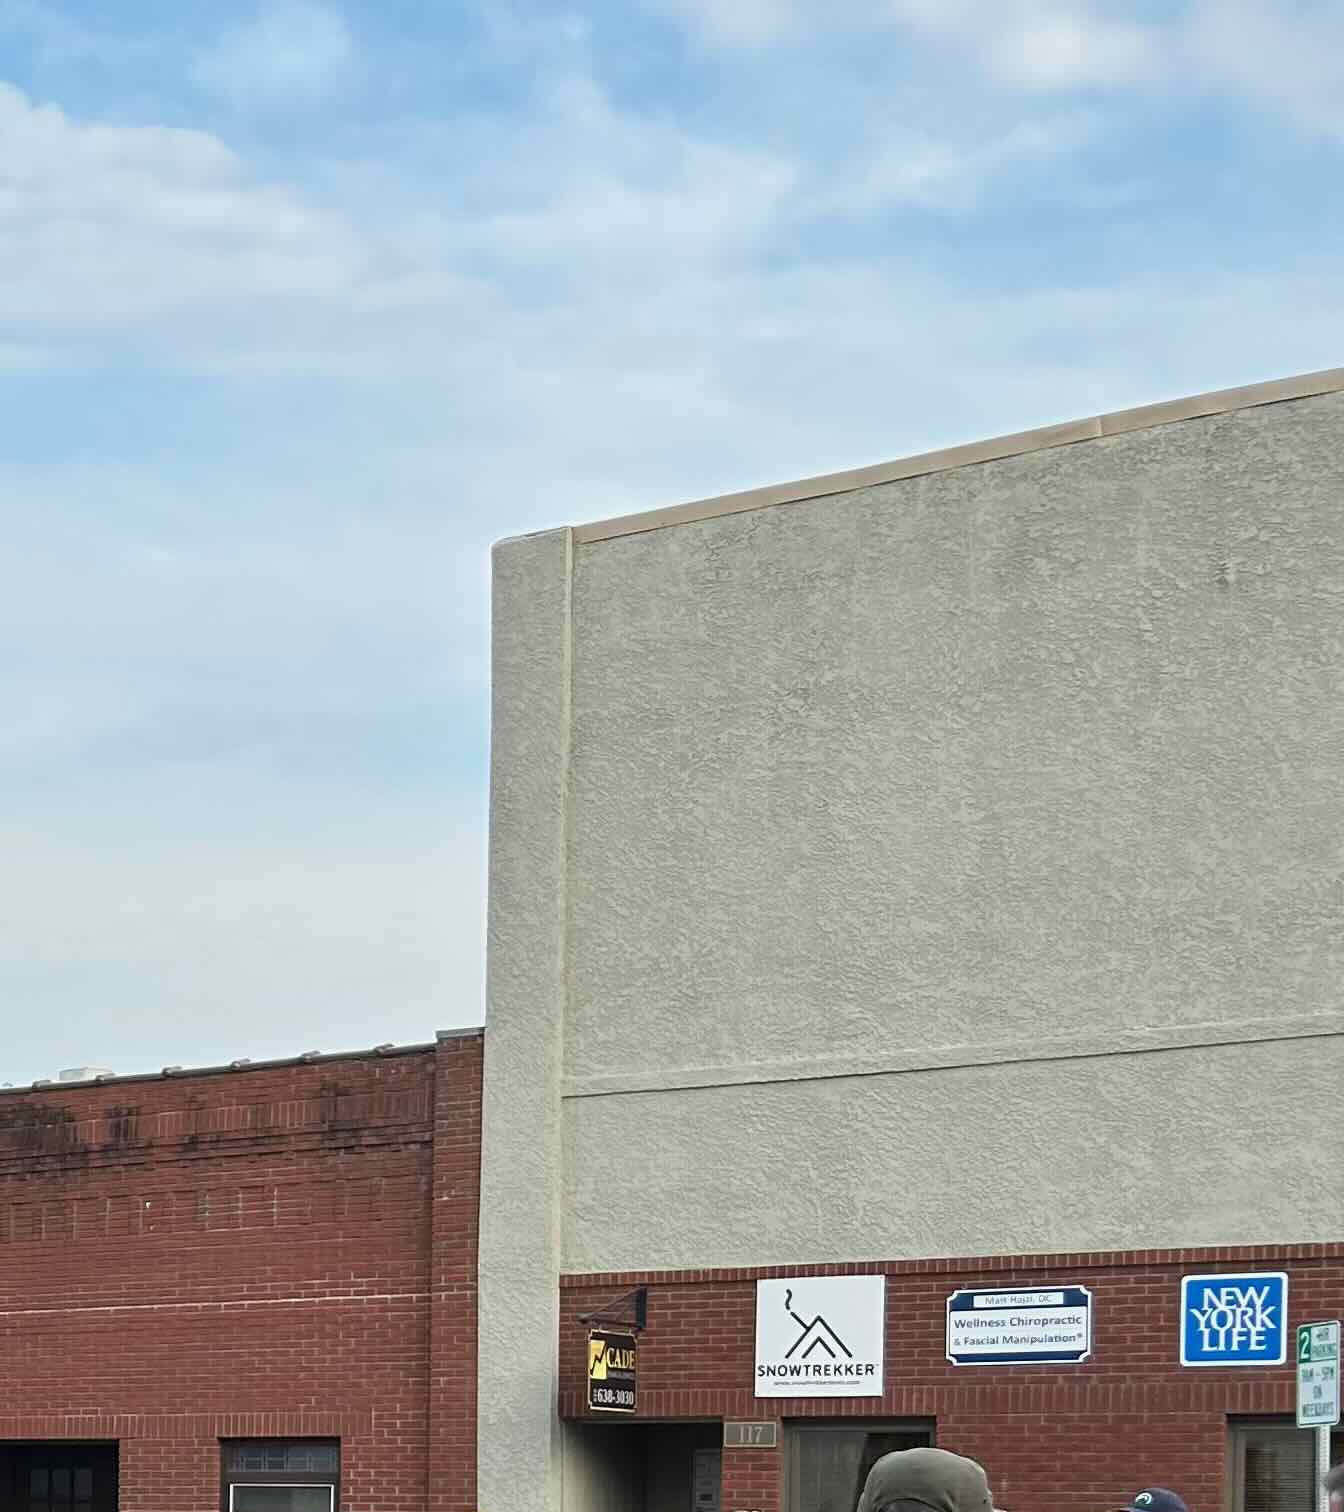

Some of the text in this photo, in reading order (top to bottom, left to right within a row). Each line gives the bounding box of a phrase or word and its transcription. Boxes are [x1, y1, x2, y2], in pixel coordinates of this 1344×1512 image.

[1201, 1286, 1271, 1310] NEW
[954, 1315, 1082, 1329] Wellness Chiropractic
[1189, 1306, 1277, 1331] YORK
[954, 1337, 961, 1346] &
[964, 1336, 999, 1346] Fascial
[1201, 1327, 1268, 1352] LIFE
[1300, 1332, 1310, 1359] 2
[757, 1364, 875, 1377] SNOWTREKKER
[738, 1426, 764, 1443] 117
